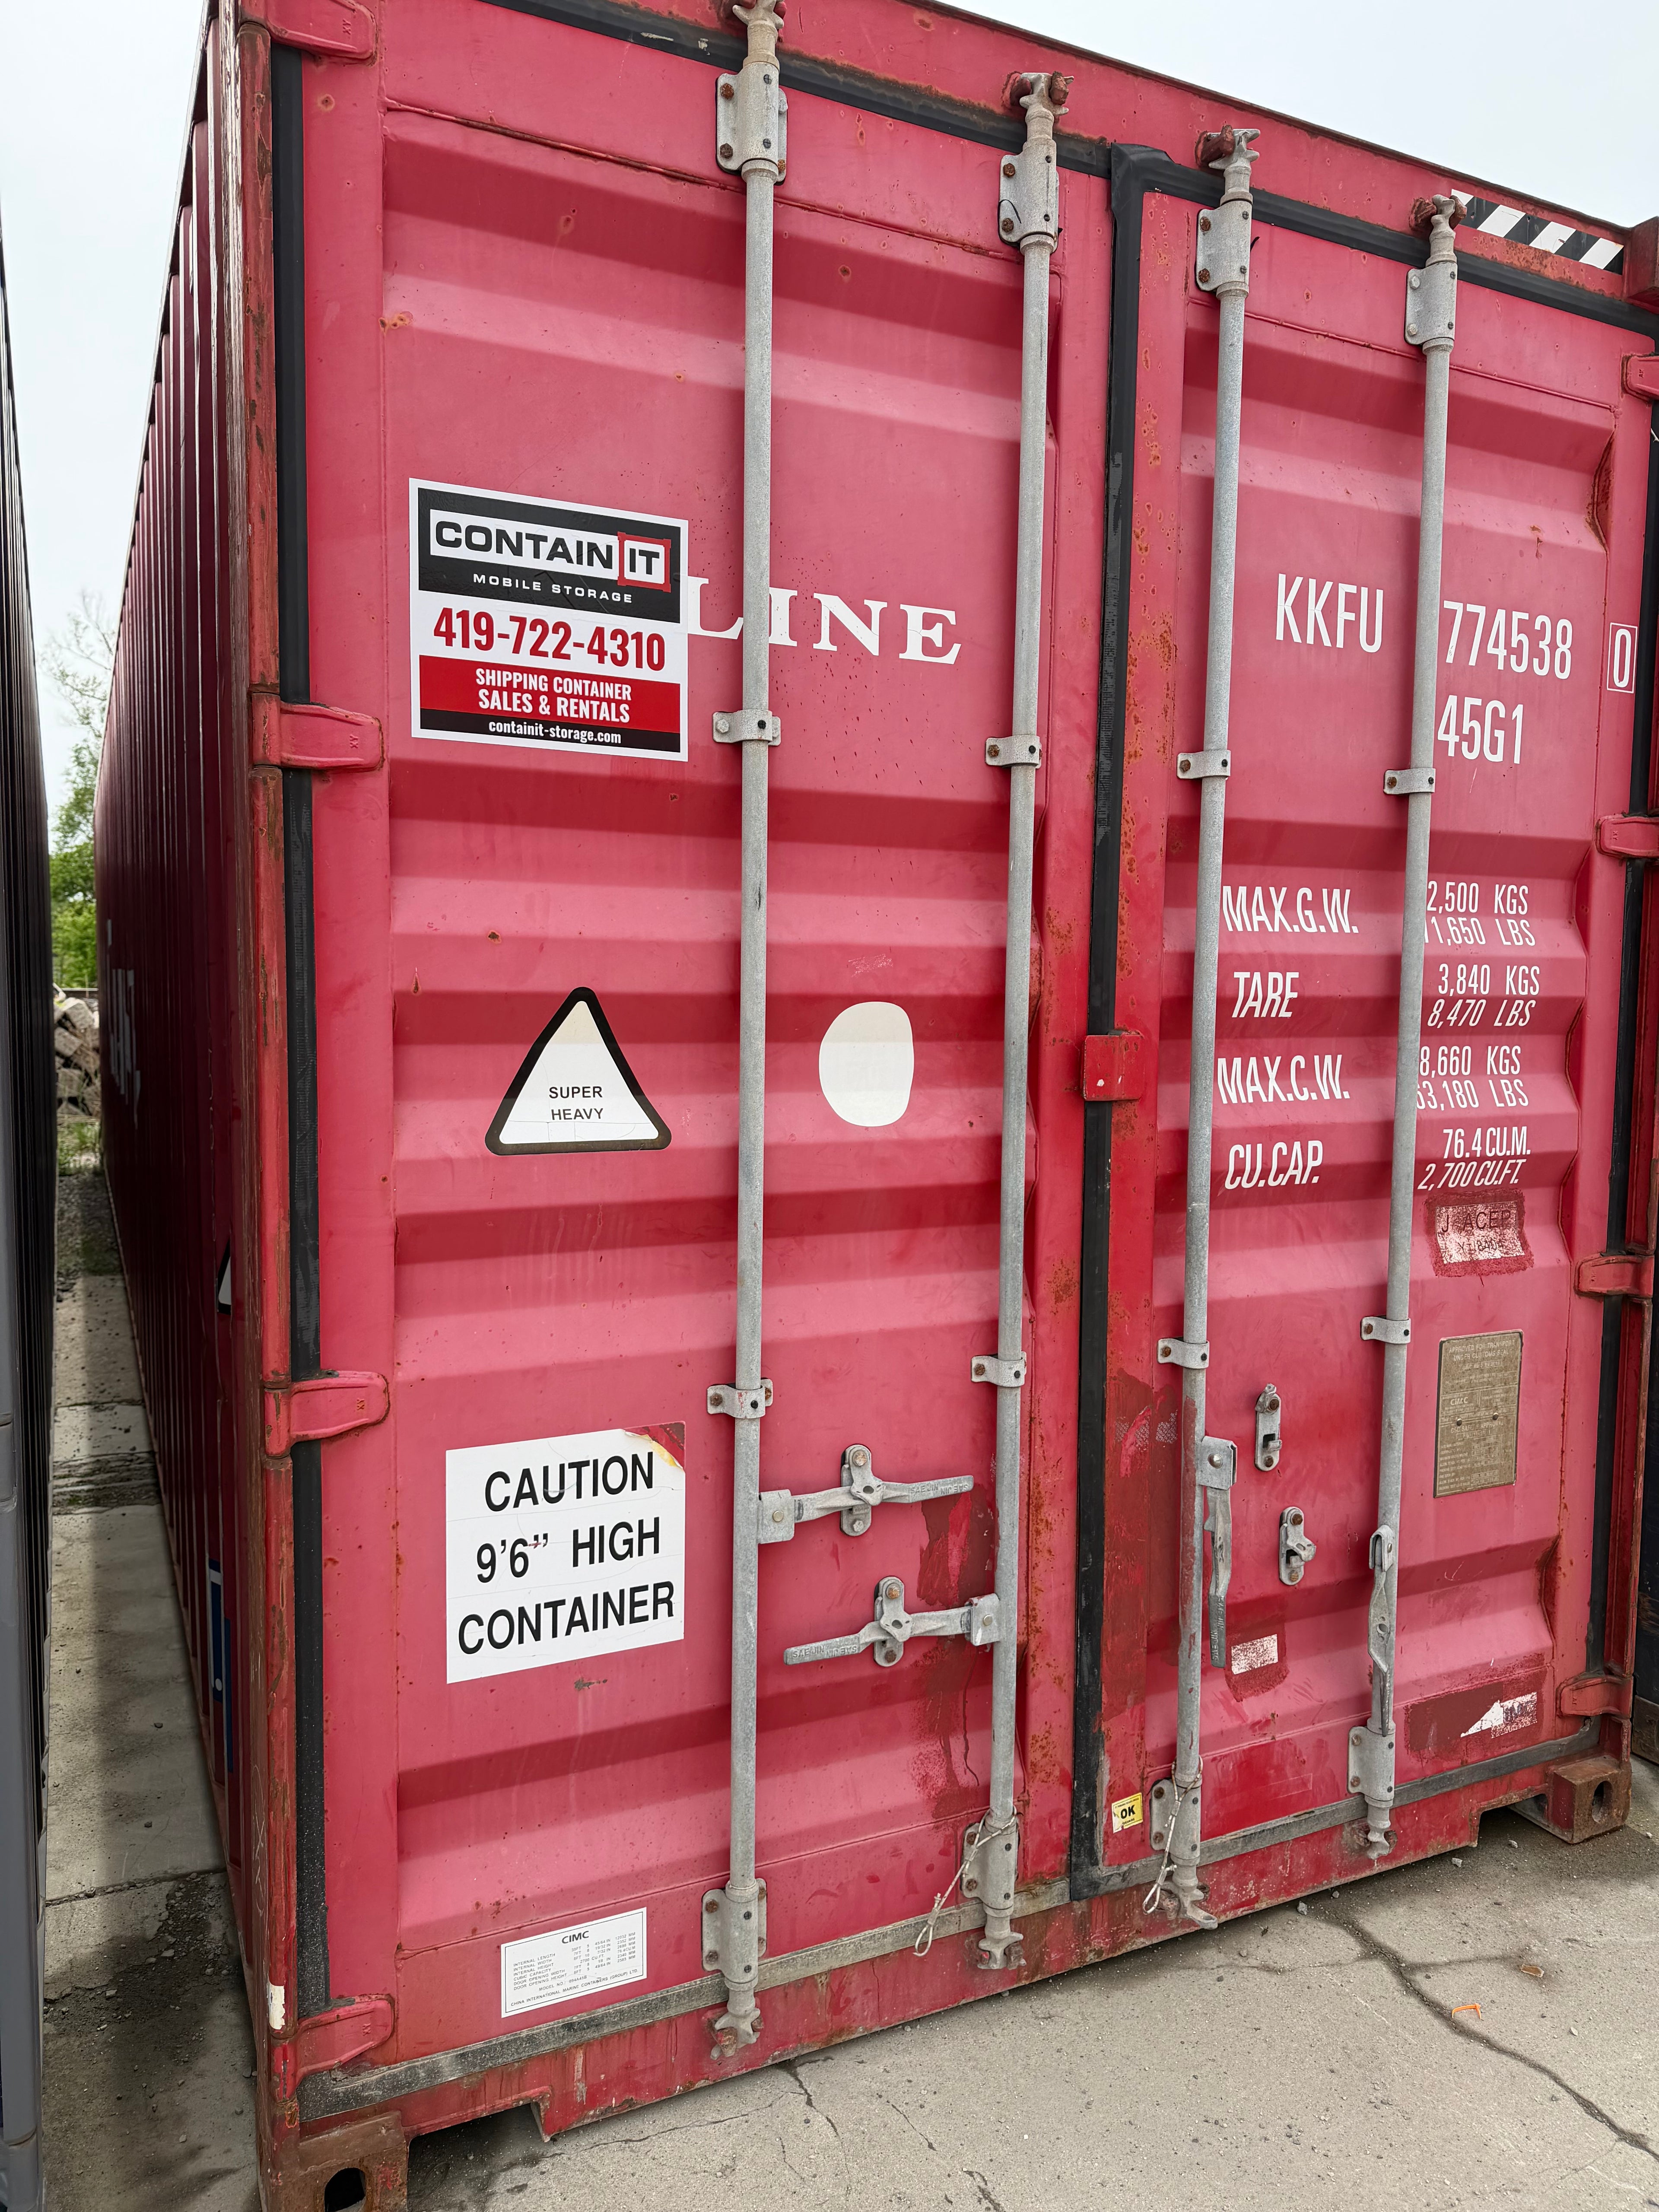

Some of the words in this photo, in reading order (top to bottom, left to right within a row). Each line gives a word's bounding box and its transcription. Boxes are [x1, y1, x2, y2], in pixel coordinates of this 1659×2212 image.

[474, 573, 542, 591] MOBILE
[552, 584, 633, 603] STORAGE
[433, 607, 665, 671] 419-722-4310
[1276, 573, 1384, 653] KKFU
[1443, 600, 1573, 680] 774538
[1613, 628, 1631, 688] 0
[476, 668, 548, 692] SHIPPING
[553, 677, 632, 701] CONTAINER
[479, 689, 532, 713] SALES
[539, 699, 550, 715] &
[557, 699, 629, 723] RENTALS
[489, 720, 621, 744] containit-storage.com
[1437, 694, 1524, 764] 45G1
[1222, 885, 1359, 934] MAX.G.W.
[1427, 880, 1479, 914] 2,500
[1494, 884, 1529, 915] KGS
[1497, 918, 1535, 946] LBS
[1232, 972, 1300, 1018] TARE
[1438, 964, 1490, 997] 3,840
[1505, 965, 1540, 995] KGS
[1427, 999, 1487, 1029] 8,470
[1494, 1000, 1536, 1027] LBS
[1217, 1054, 1351, 1105] MAX.C.W.
[1420, 1046, 1471, 1078] 8,660
[1487, 1046, 1521, 1076] KGS
[549, 1086, 603, 1099] SUPER
[1488, 1079, 1529, 1107] LBS
[551, 1108, 604, 1120] HEAVY
[1224, 1140, 1323, 1190] CU.CAP.
[1443, 1128, 1481, 1159] 76.4
[1486, 1126, 1531, 1157] CU.M.
[1417, 1161, 1477, 1191] 2,700
[1474, 1159, 1527, 1186] CU.FT.
[1449, 1344, 1474, 1353] APPROVED
[1487, 1340, 1515, 1349] TRANSPORT
[1450, 1397, 1468, 1405] CIMC
[485, 1452, 654, 1512] CAUTION
[572, 1516, 660, 1567] HIGH
[458, 1581, 674, 1655] CONTAINER
[1120, 1804, 1135, 1819] OK
[562, 1930, 589, 1944] CIMC
[513, 1958, 535, 1967] INTERNAL
[513, 1963, 535, 1971] INTERNAL
[513, 1968, 535, 1976] INTERNAL
[530, 1968, 551, 1977] CAPACITY
[526, 1990, 561, 2002] INTERNATIONAL
[581, 1977, 608, 1987] CONTAINERS
[610, 1971, 628, 1980] (GROUP)
